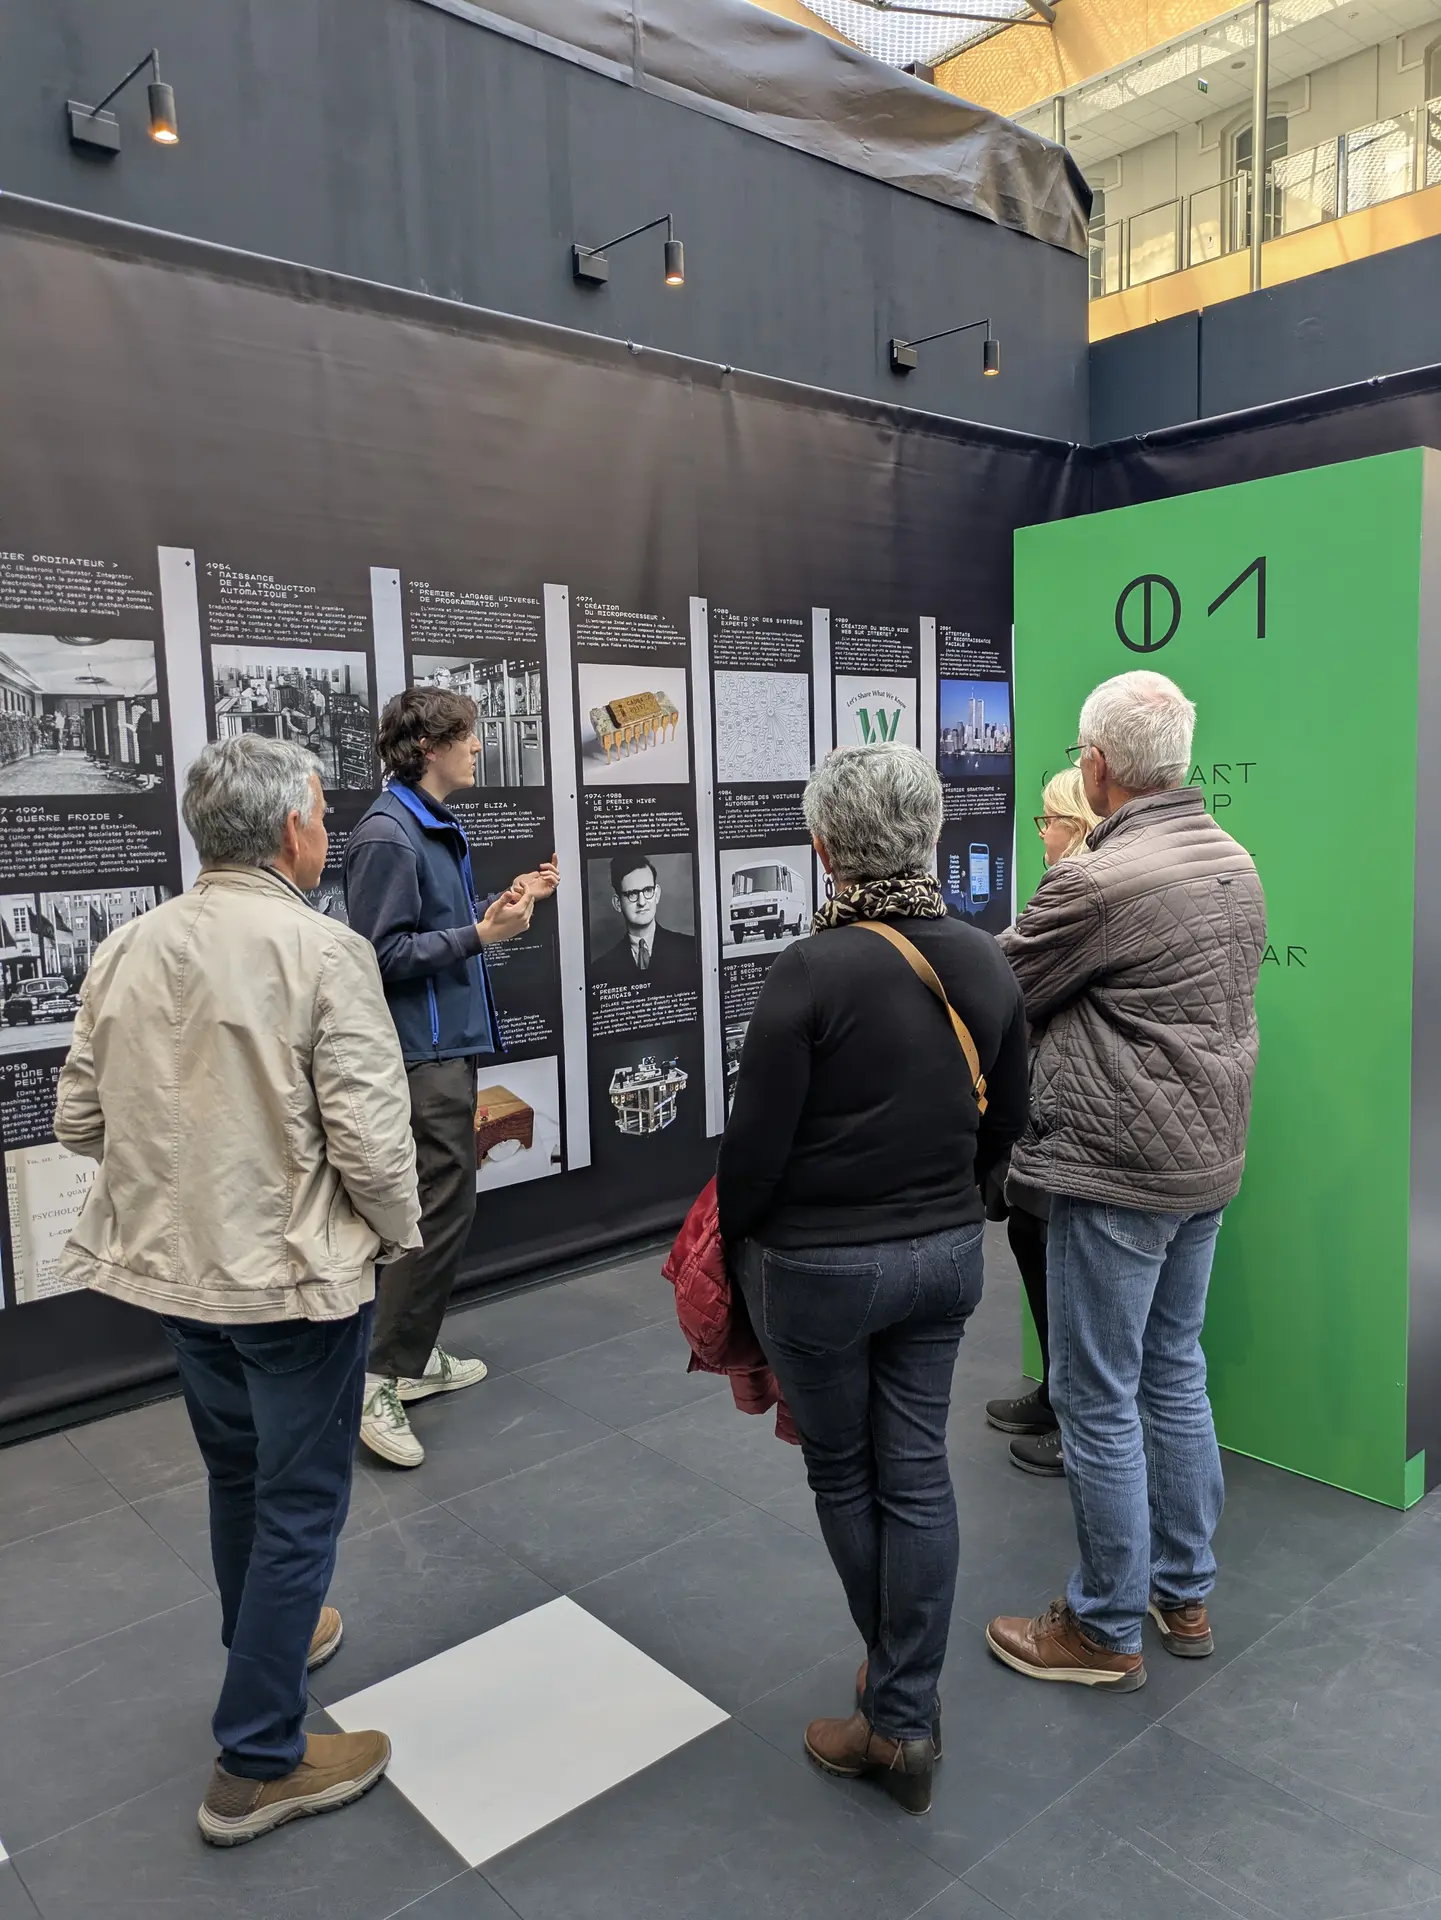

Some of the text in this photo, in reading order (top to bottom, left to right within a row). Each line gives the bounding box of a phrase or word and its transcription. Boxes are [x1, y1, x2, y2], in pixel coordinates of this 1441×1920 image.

[32, 555, 105, 567] ORDINATEUR
[206, 562, 231, 570] 1954
[219, 572, 274, 582] NAISSANCE
[220, 588, 287, 598] AUTOMATIQUE
[257, 583, 316, 593] TRADUCTION
[420, 589, 455, 597] PREMIER
[498, 596, 540, 605] UNIVERSEL
[435, 598, 499, 608] PROGRAMMATION
[584, 602, 620, 610] CRÉATION
[597, 611, 658, 620] MICROPROCESSEUR
[846, 697, 857, 707] Let's
[857, 691, 871, 700] Share
[894, 696, 906, 708] Know
[16, 814, 60, 822] GUERRE
[68, 813, 110, 821] FROIDE
[740, 967, 762, 975] SECOND
[600, 986, 628, 995] PREMIER
[600, 991, 632, 1001] FRANÇAIS
[0, 1063, 27, 1073] 1950
[2, 1120, 31, 1129] personne
